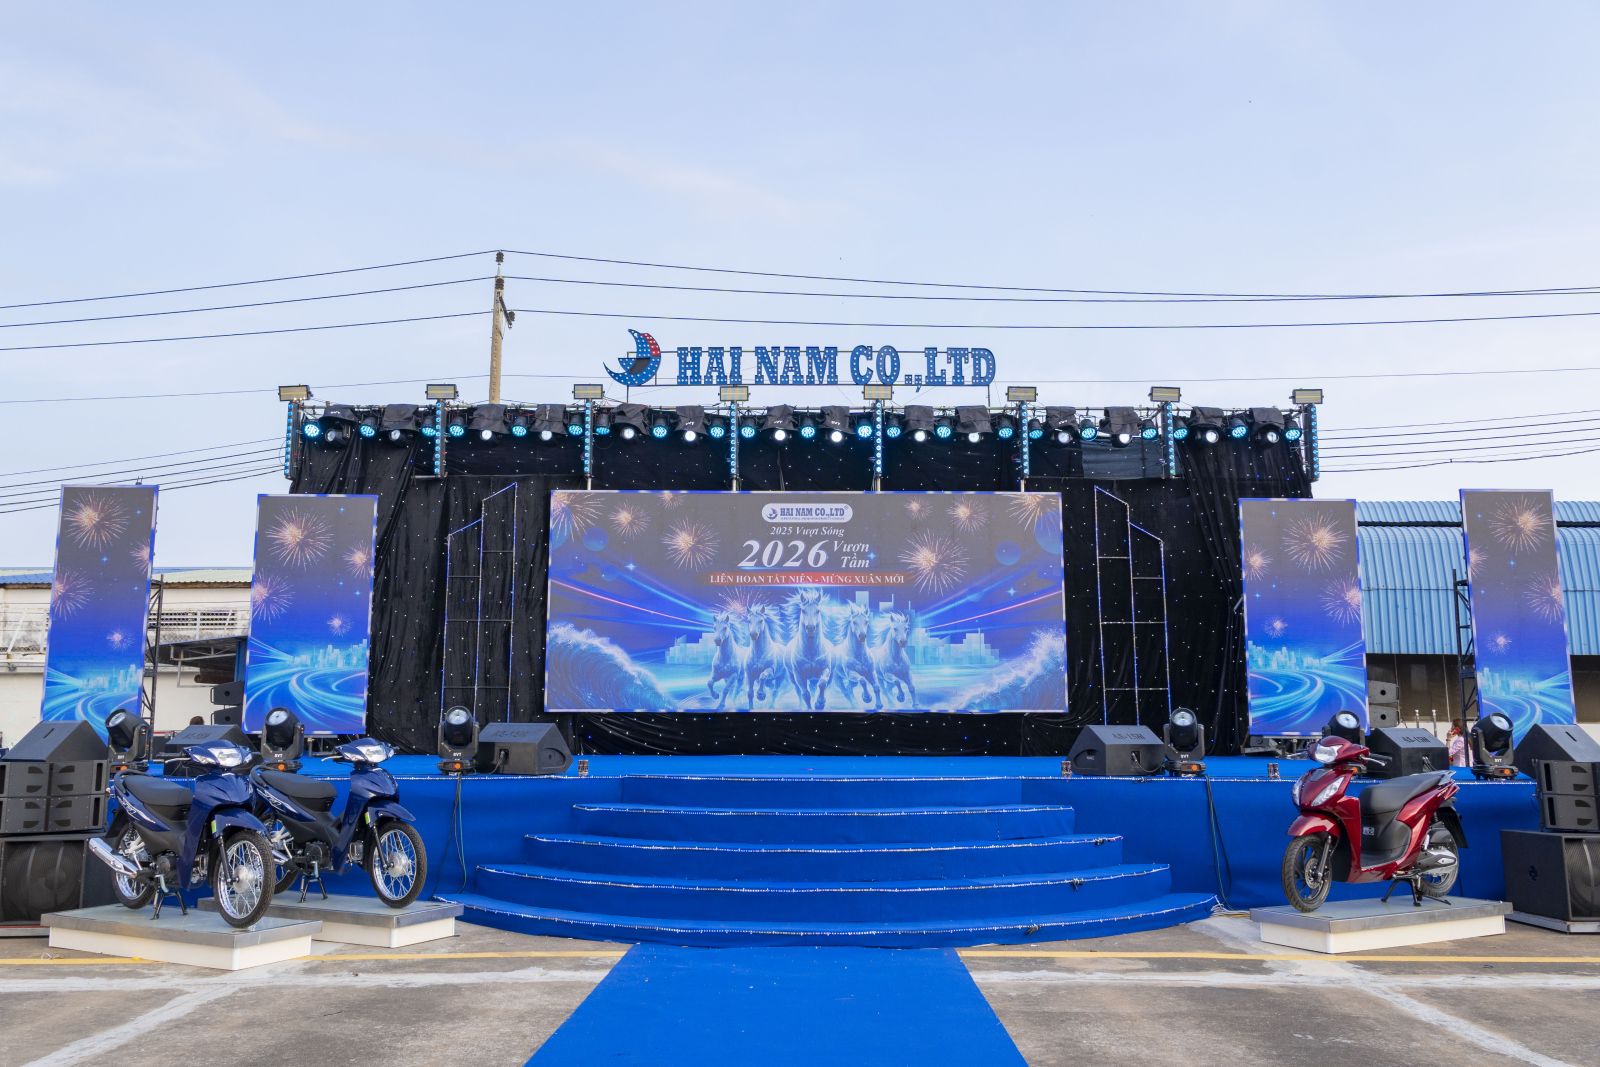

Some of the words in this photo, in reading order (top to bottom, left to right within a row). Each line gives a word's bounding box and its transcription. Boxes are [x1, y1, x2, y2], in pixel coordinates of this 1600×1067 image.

[677, 346, 742, 385] HAI
[755, 346, 838, 385] NAM
[780, 507, 795, 517] HAI
[795, 507, 813, 517] NAM
[770, 526, 793, 536] 2025
[796, 526, 819, 537] Vượt
[820, 526, 845, 538] Sóng
[833, 540, 870, 552] Vươn
[737, 539, 830, 568] 2026
[840, 552, 870, 568] Tầm
[710, 573, 733, 583] LIÊN
[736, 575, 765, 583] HOAN
[789, 573, 812, 583] NIÊN
[820, 573, 852, 583] MỪNG
[854, 573, 883, 583] XUÂN
